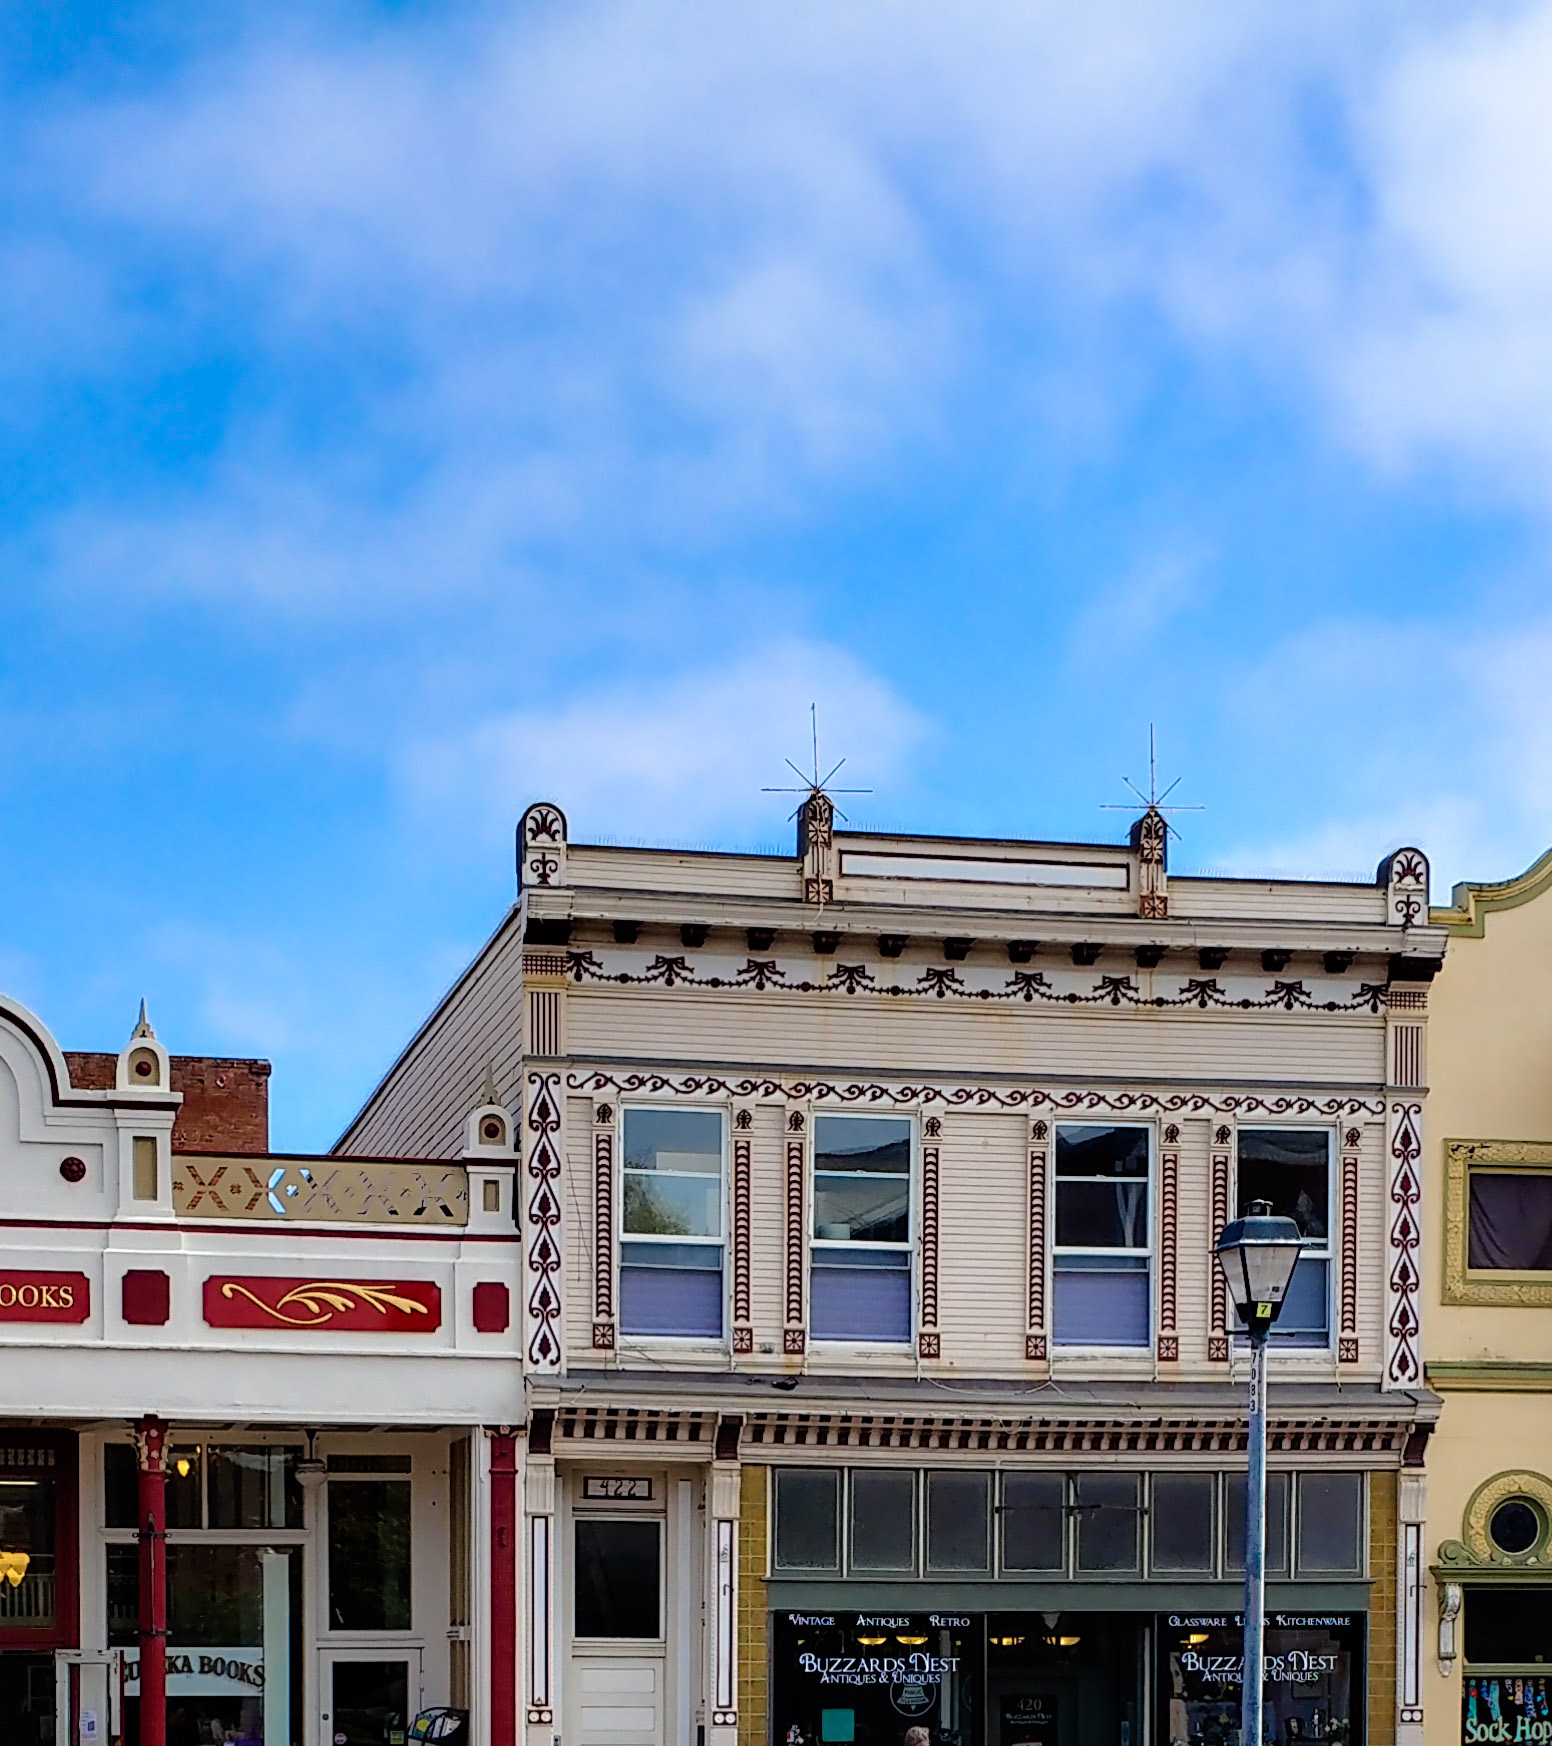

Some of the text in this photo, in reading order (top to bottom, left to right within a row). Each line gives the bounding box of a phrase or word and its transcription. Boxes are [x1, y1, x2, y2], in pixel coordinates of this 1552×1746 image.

[1261, 1304, 1268, 1315] 7
[599, 1479, 637, 1497] 422
[788, 1614, 971, 1628] VINTAGE ANTIQUES RETRO
[1168, 1615, 1227, 1627] GLASSWARE
[1276, 1614, 1351, 1627] KITCHENWARE
[799, 1652, 961, 1673] BUZZARDS NEST
[1181, 1650, 1338, 1671] BUZZDS NEST
[198, 1655, 266, 1688] BOOKS
[820, 1670, 942, 1686] ANTIQUES & UNIQUES
[1271, 1669, 1319, 1683] UNIQUES
[1016, 1698, 1042, 1711] 420
[1464, 1715, 1552, 1746] Sock Hop
